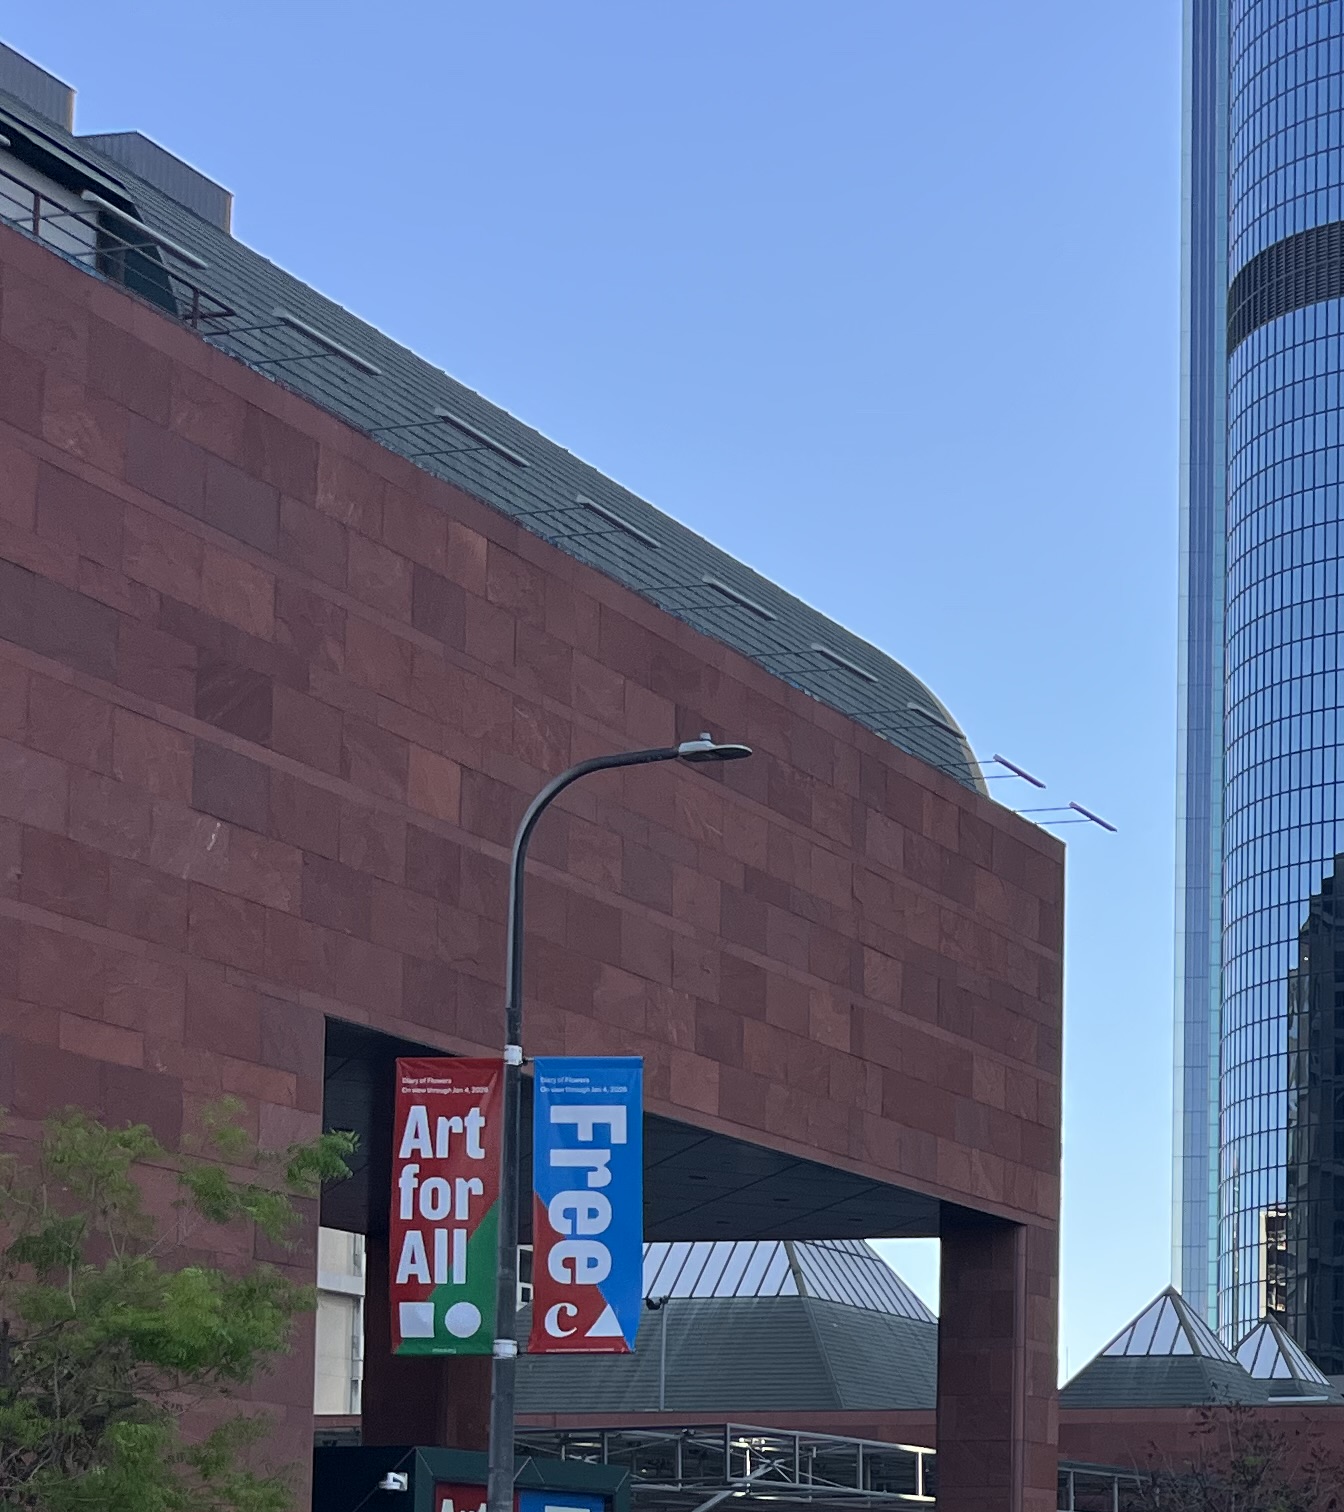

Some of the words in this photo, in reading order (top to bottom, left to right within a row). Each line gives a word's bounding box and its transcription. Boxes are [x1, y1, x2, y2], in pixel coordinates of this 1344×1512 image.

[398, 1105, 486, 1159] Art
[399, 1164, 484, 1220] for
[548, 1105, 627, 1285] Free
[396, 1228, 467, 1284] All
